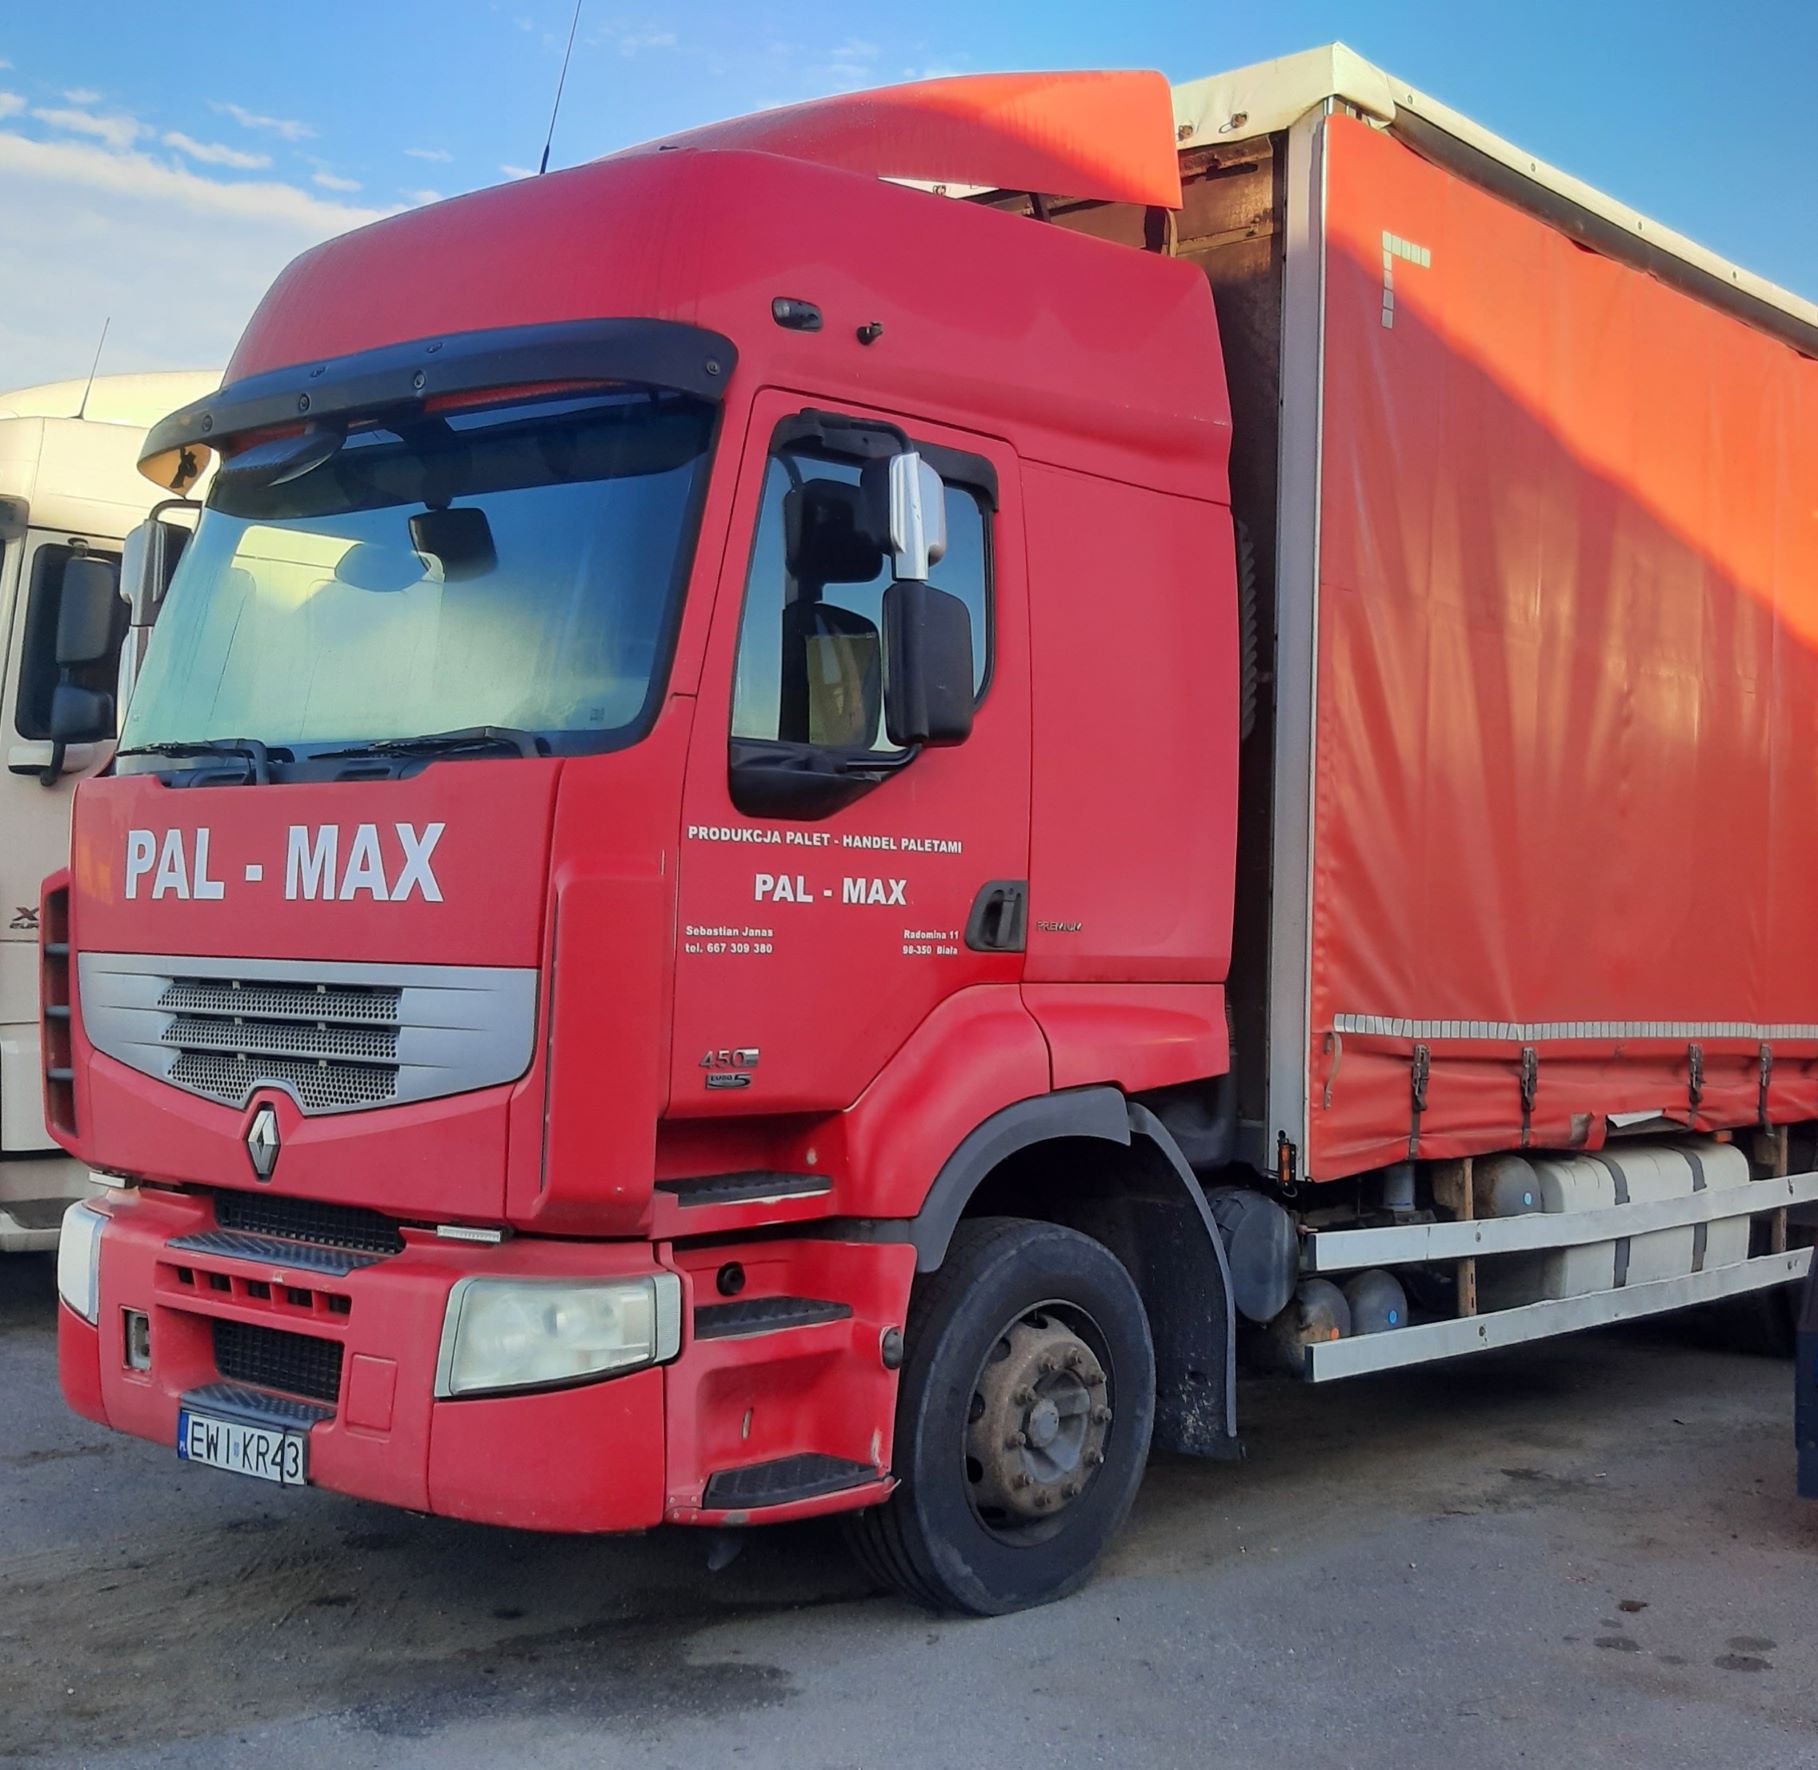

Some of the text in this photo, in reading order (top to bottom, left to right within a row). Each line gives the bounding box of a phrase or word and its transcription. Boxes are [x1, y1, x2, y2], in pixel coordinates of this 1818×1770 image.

[687, 826, 781, 843] PRODUKCJA
[785, 831, 831, 846] PALET
[842, 835, 898, 850] HANDEL
[901, 838, 962, 854] PALETAMI
[125, 822, 446, 902] PAL - MAX
[754, 873, 907, 905] PAL - MAX
[685, 925, 773, 937] Sebastian Janas
[904, 929, 959, 940] Radomina 11
[1036, 920, 1082, 932] PREMIUM
[685, 943, 773, 954] tel. 667 309 380
[699, 1049, 746, 1068] 450
[191, 1421, 230, 1465] EWI
